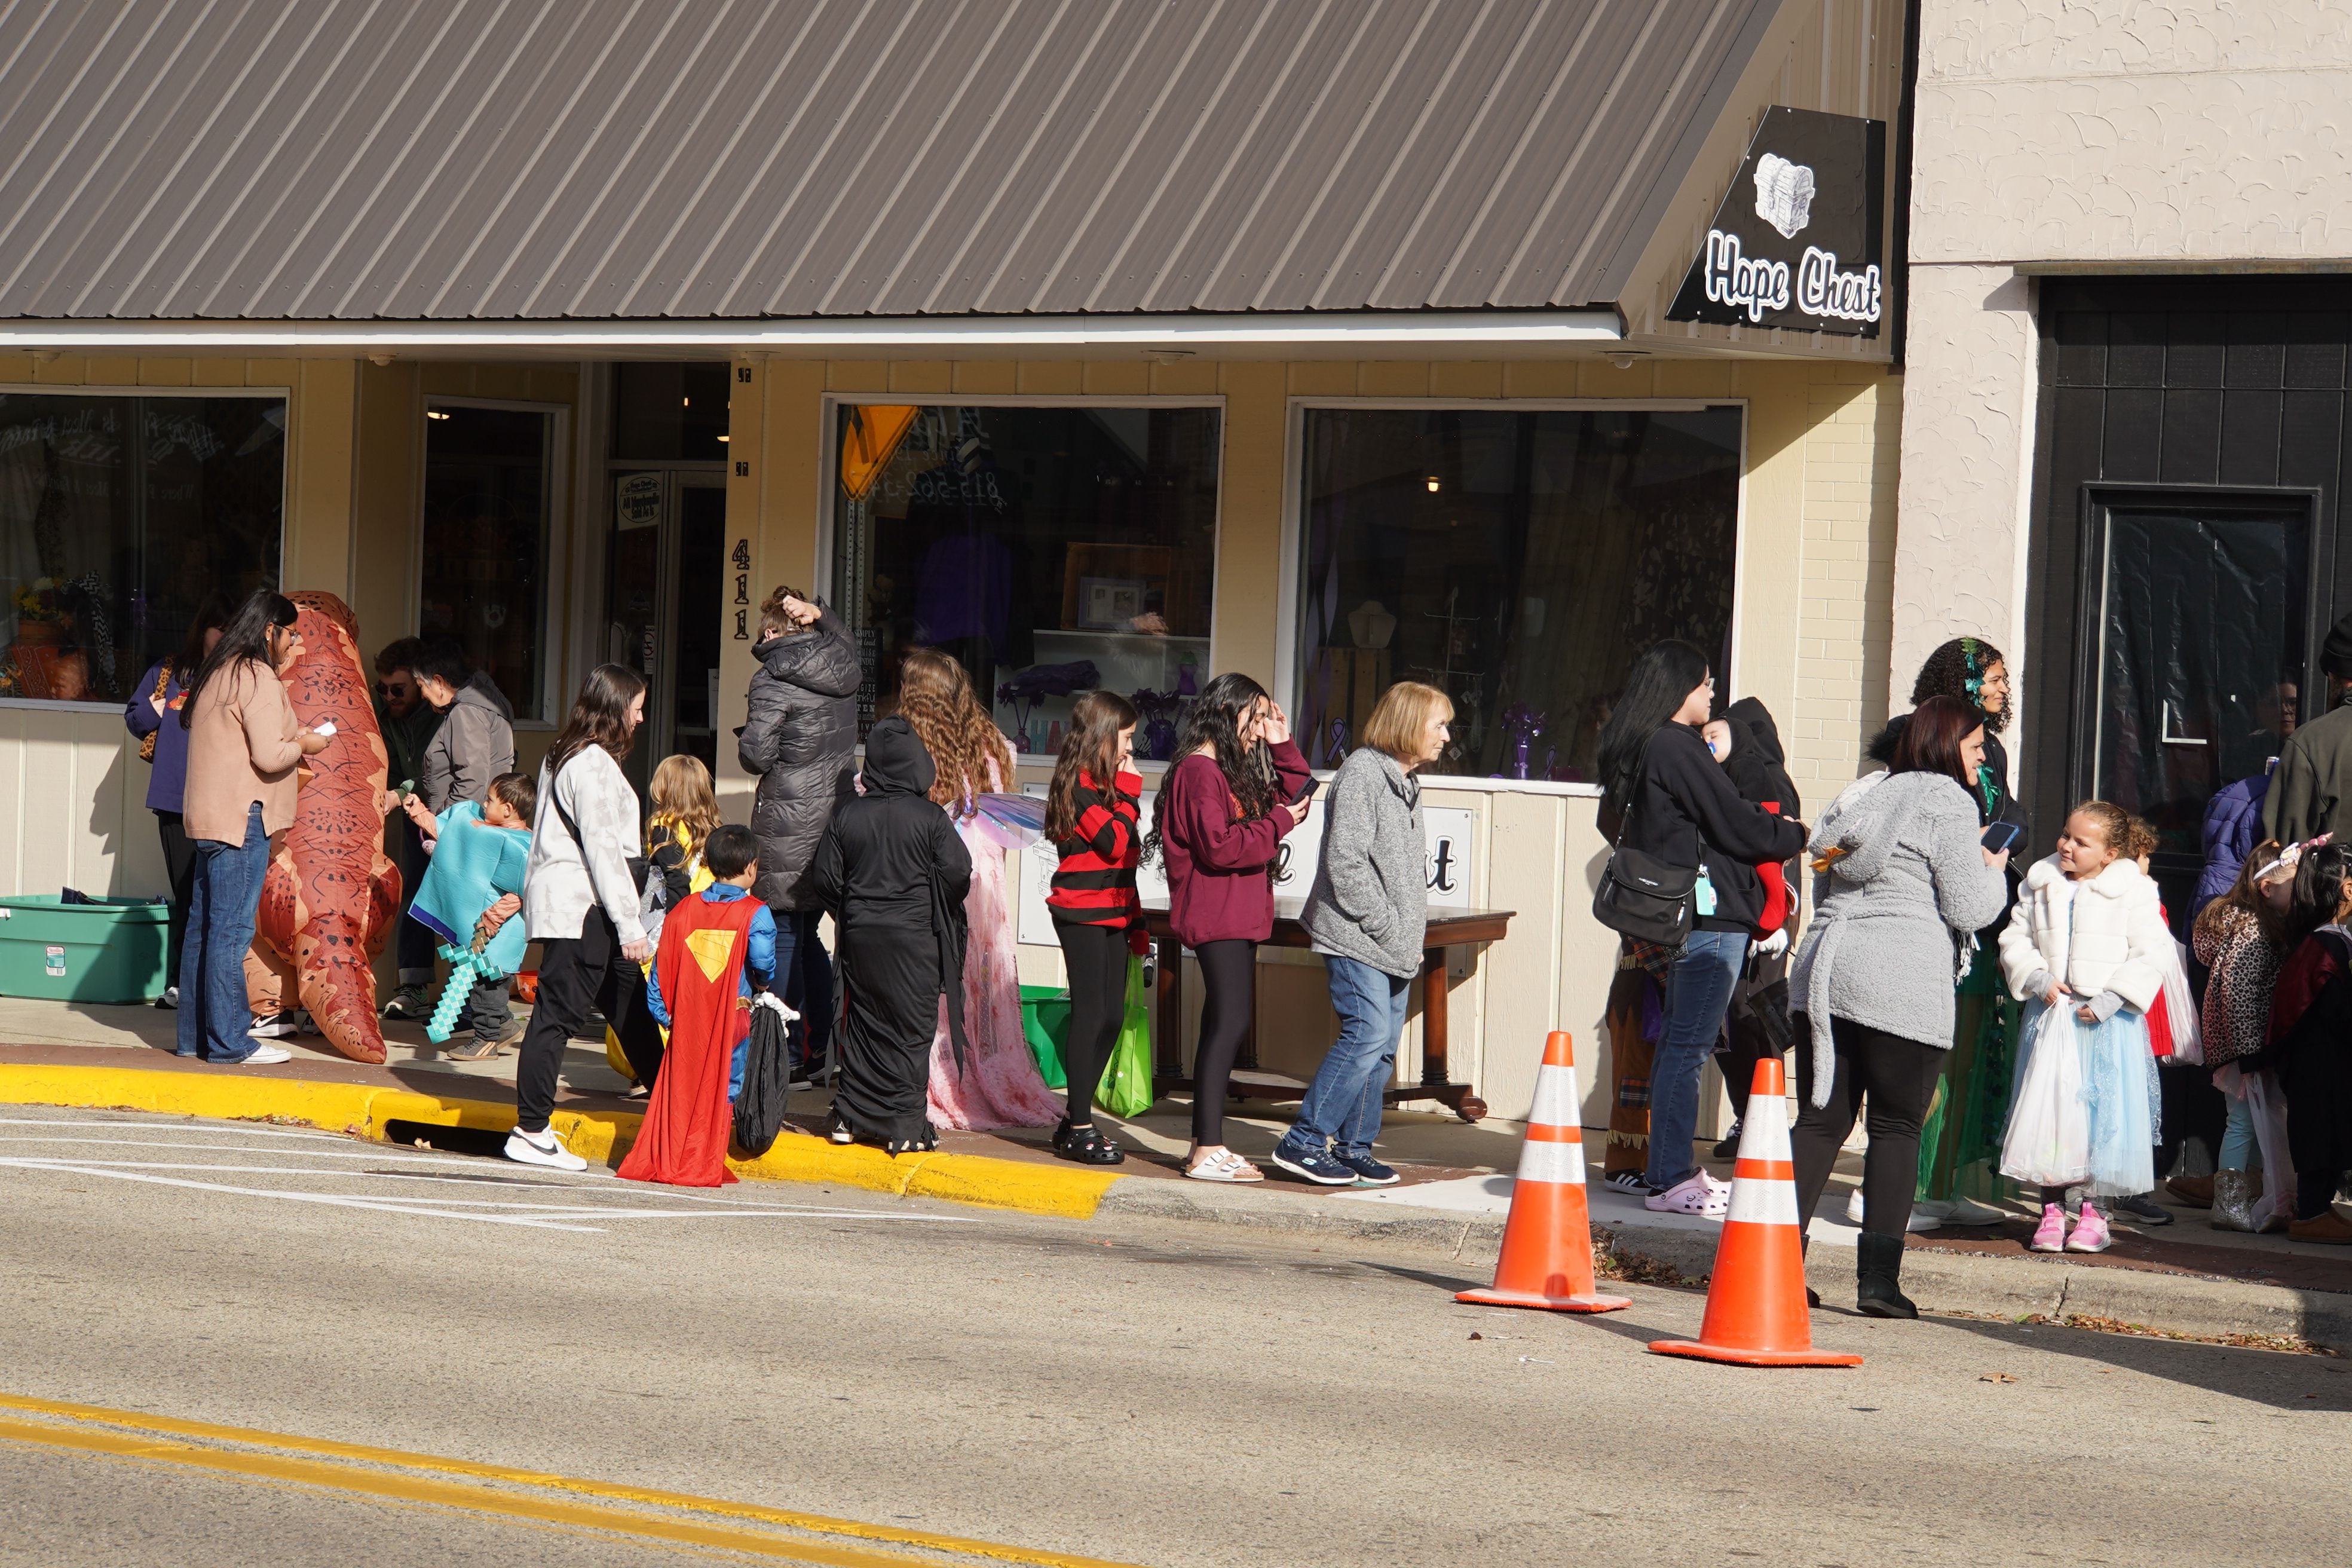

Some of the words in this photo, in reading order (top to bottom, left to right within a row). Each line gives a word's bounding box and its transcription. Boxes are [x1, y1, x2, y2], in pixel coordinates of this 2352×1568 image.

[1706, 229, 1789, 321] Hope
[1797, 246, 1881, 322] Chest
[732, 539, 750, 639] 411
[860, 657, 875, 666] INDLY
